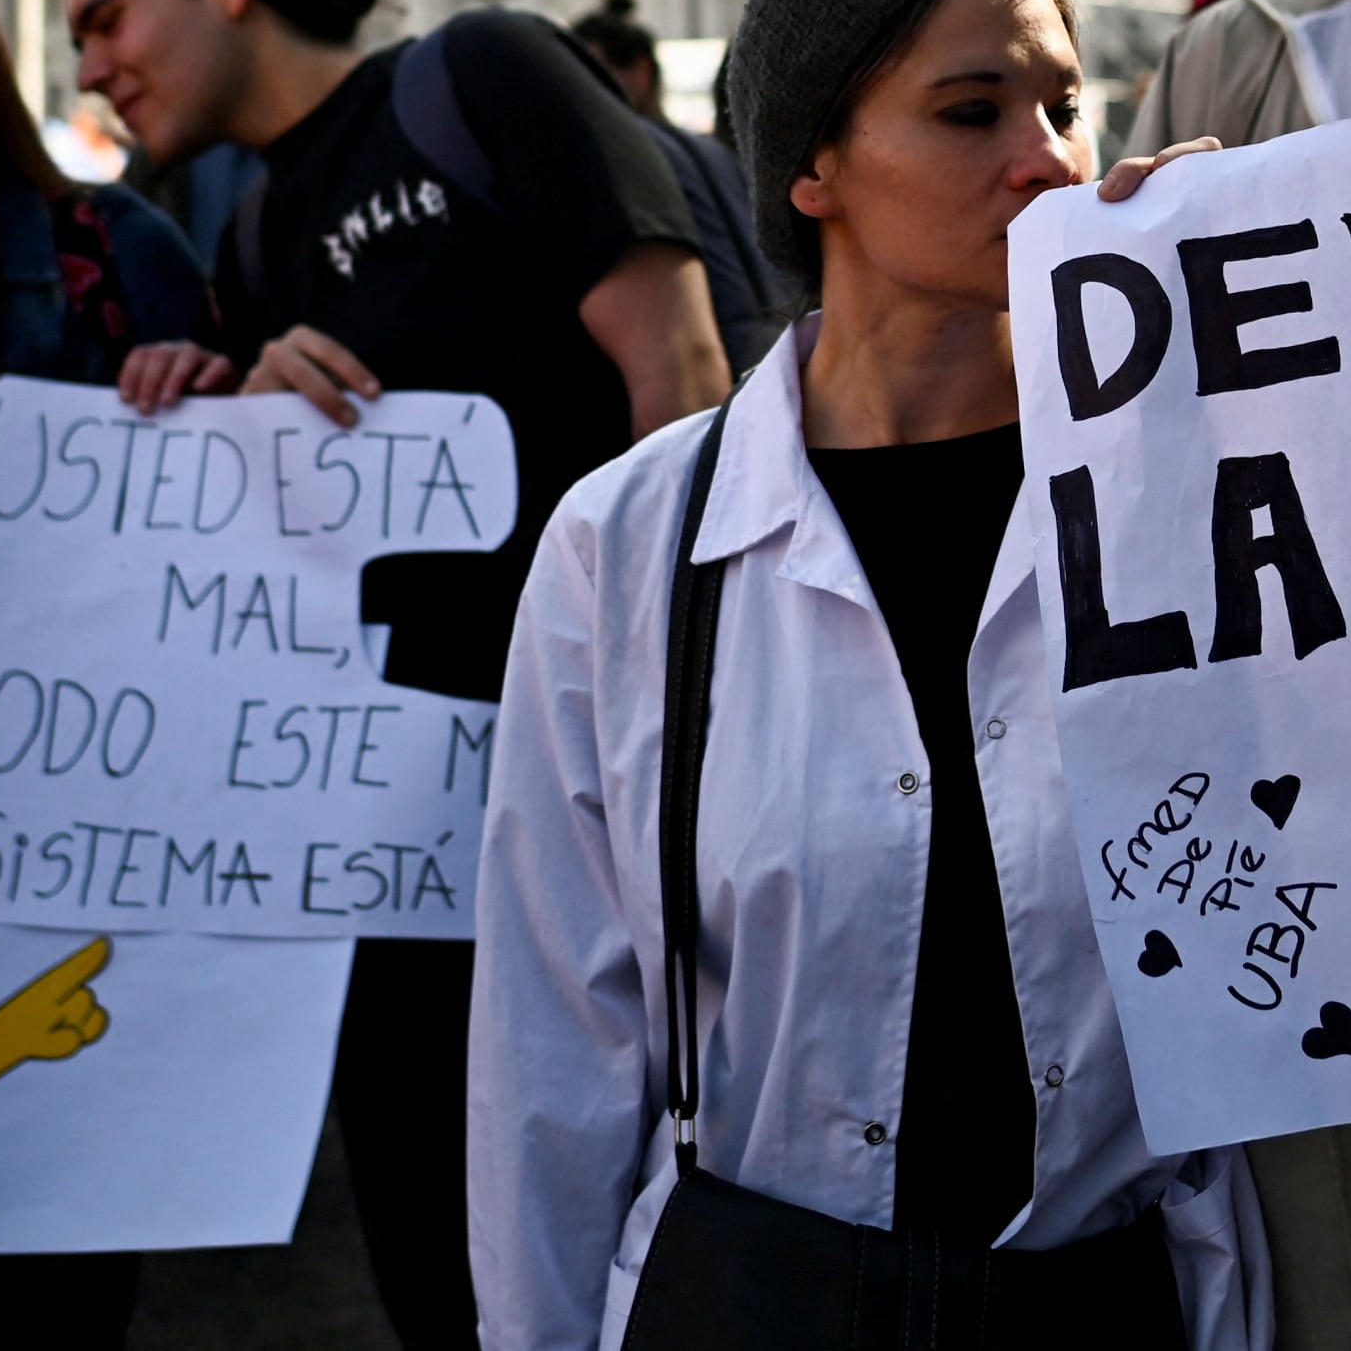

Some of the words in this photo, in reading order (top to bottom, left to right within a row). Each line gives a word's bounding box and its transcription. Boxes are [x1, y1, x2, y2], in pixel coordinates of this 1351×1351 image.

[273, 402, 482, 539] ESTÁ
[157, 563, 351, 669] MAL,
[1048, 452, 1348, 694] LA
[228, 699, 403, 791] ESTE
[300, 831, 457, 916] ESTÁ
[1227, 882, 1338, 1011] UBA
